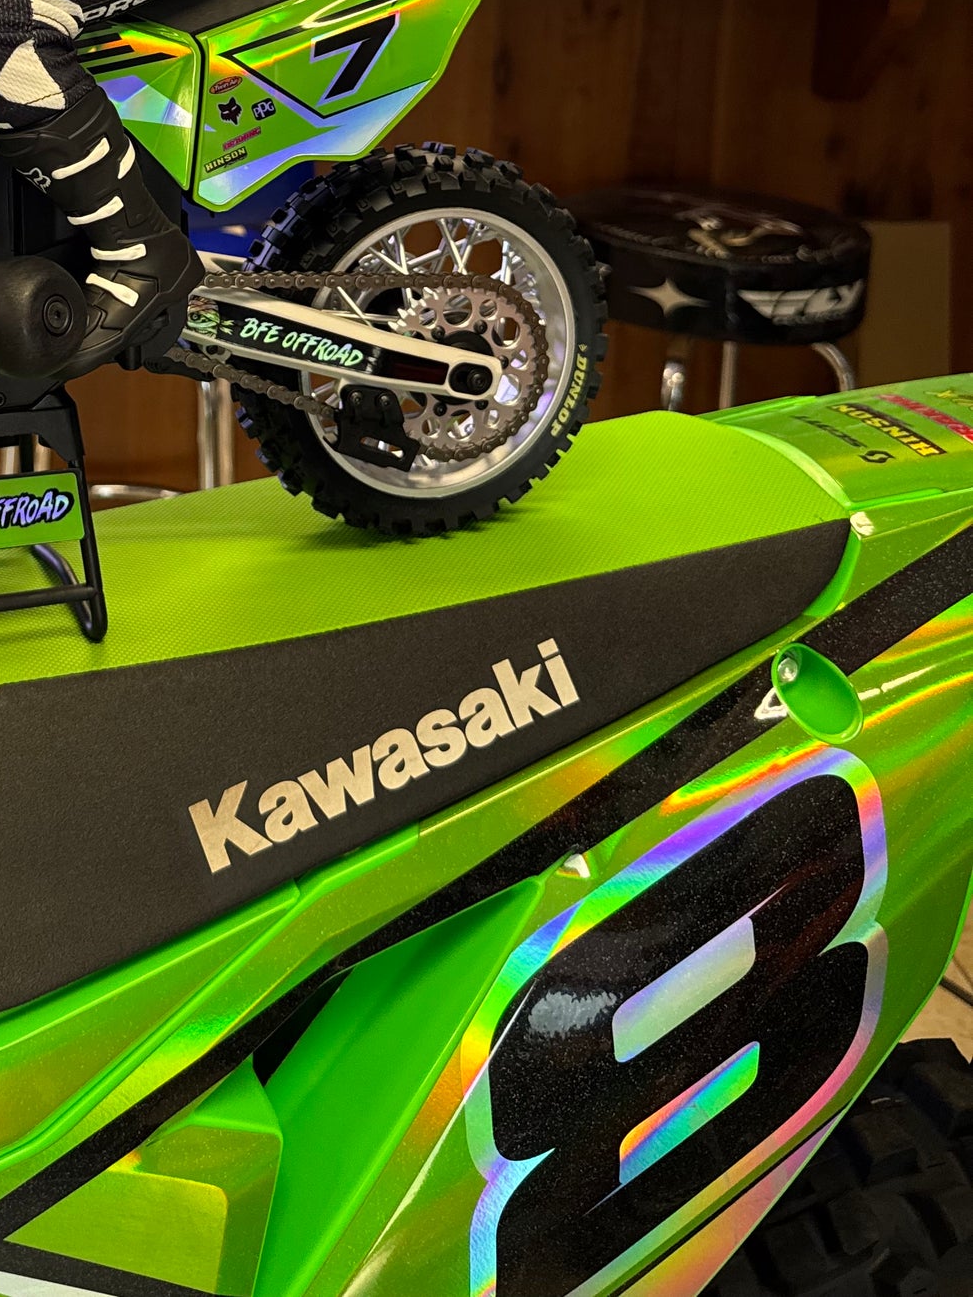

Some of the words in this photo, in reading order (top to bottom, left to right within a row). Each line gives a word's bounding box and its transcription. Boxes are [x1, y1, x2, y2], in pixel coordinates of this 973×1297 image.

[309, 9, 401, 107] 7
[252, 101, 275, 118] PPG
[205, 146, 246, 172] HINSON
[239, 317, 284, 344] BFE
[282, 331, 364, 366] OFFROAD
[550, 353, 588, 438] DUNLOP
[831, 403, 941, 457] HINSON
[187, 636, 581, 875] Kawasaki
[461, 743, 888, 1297] 8
